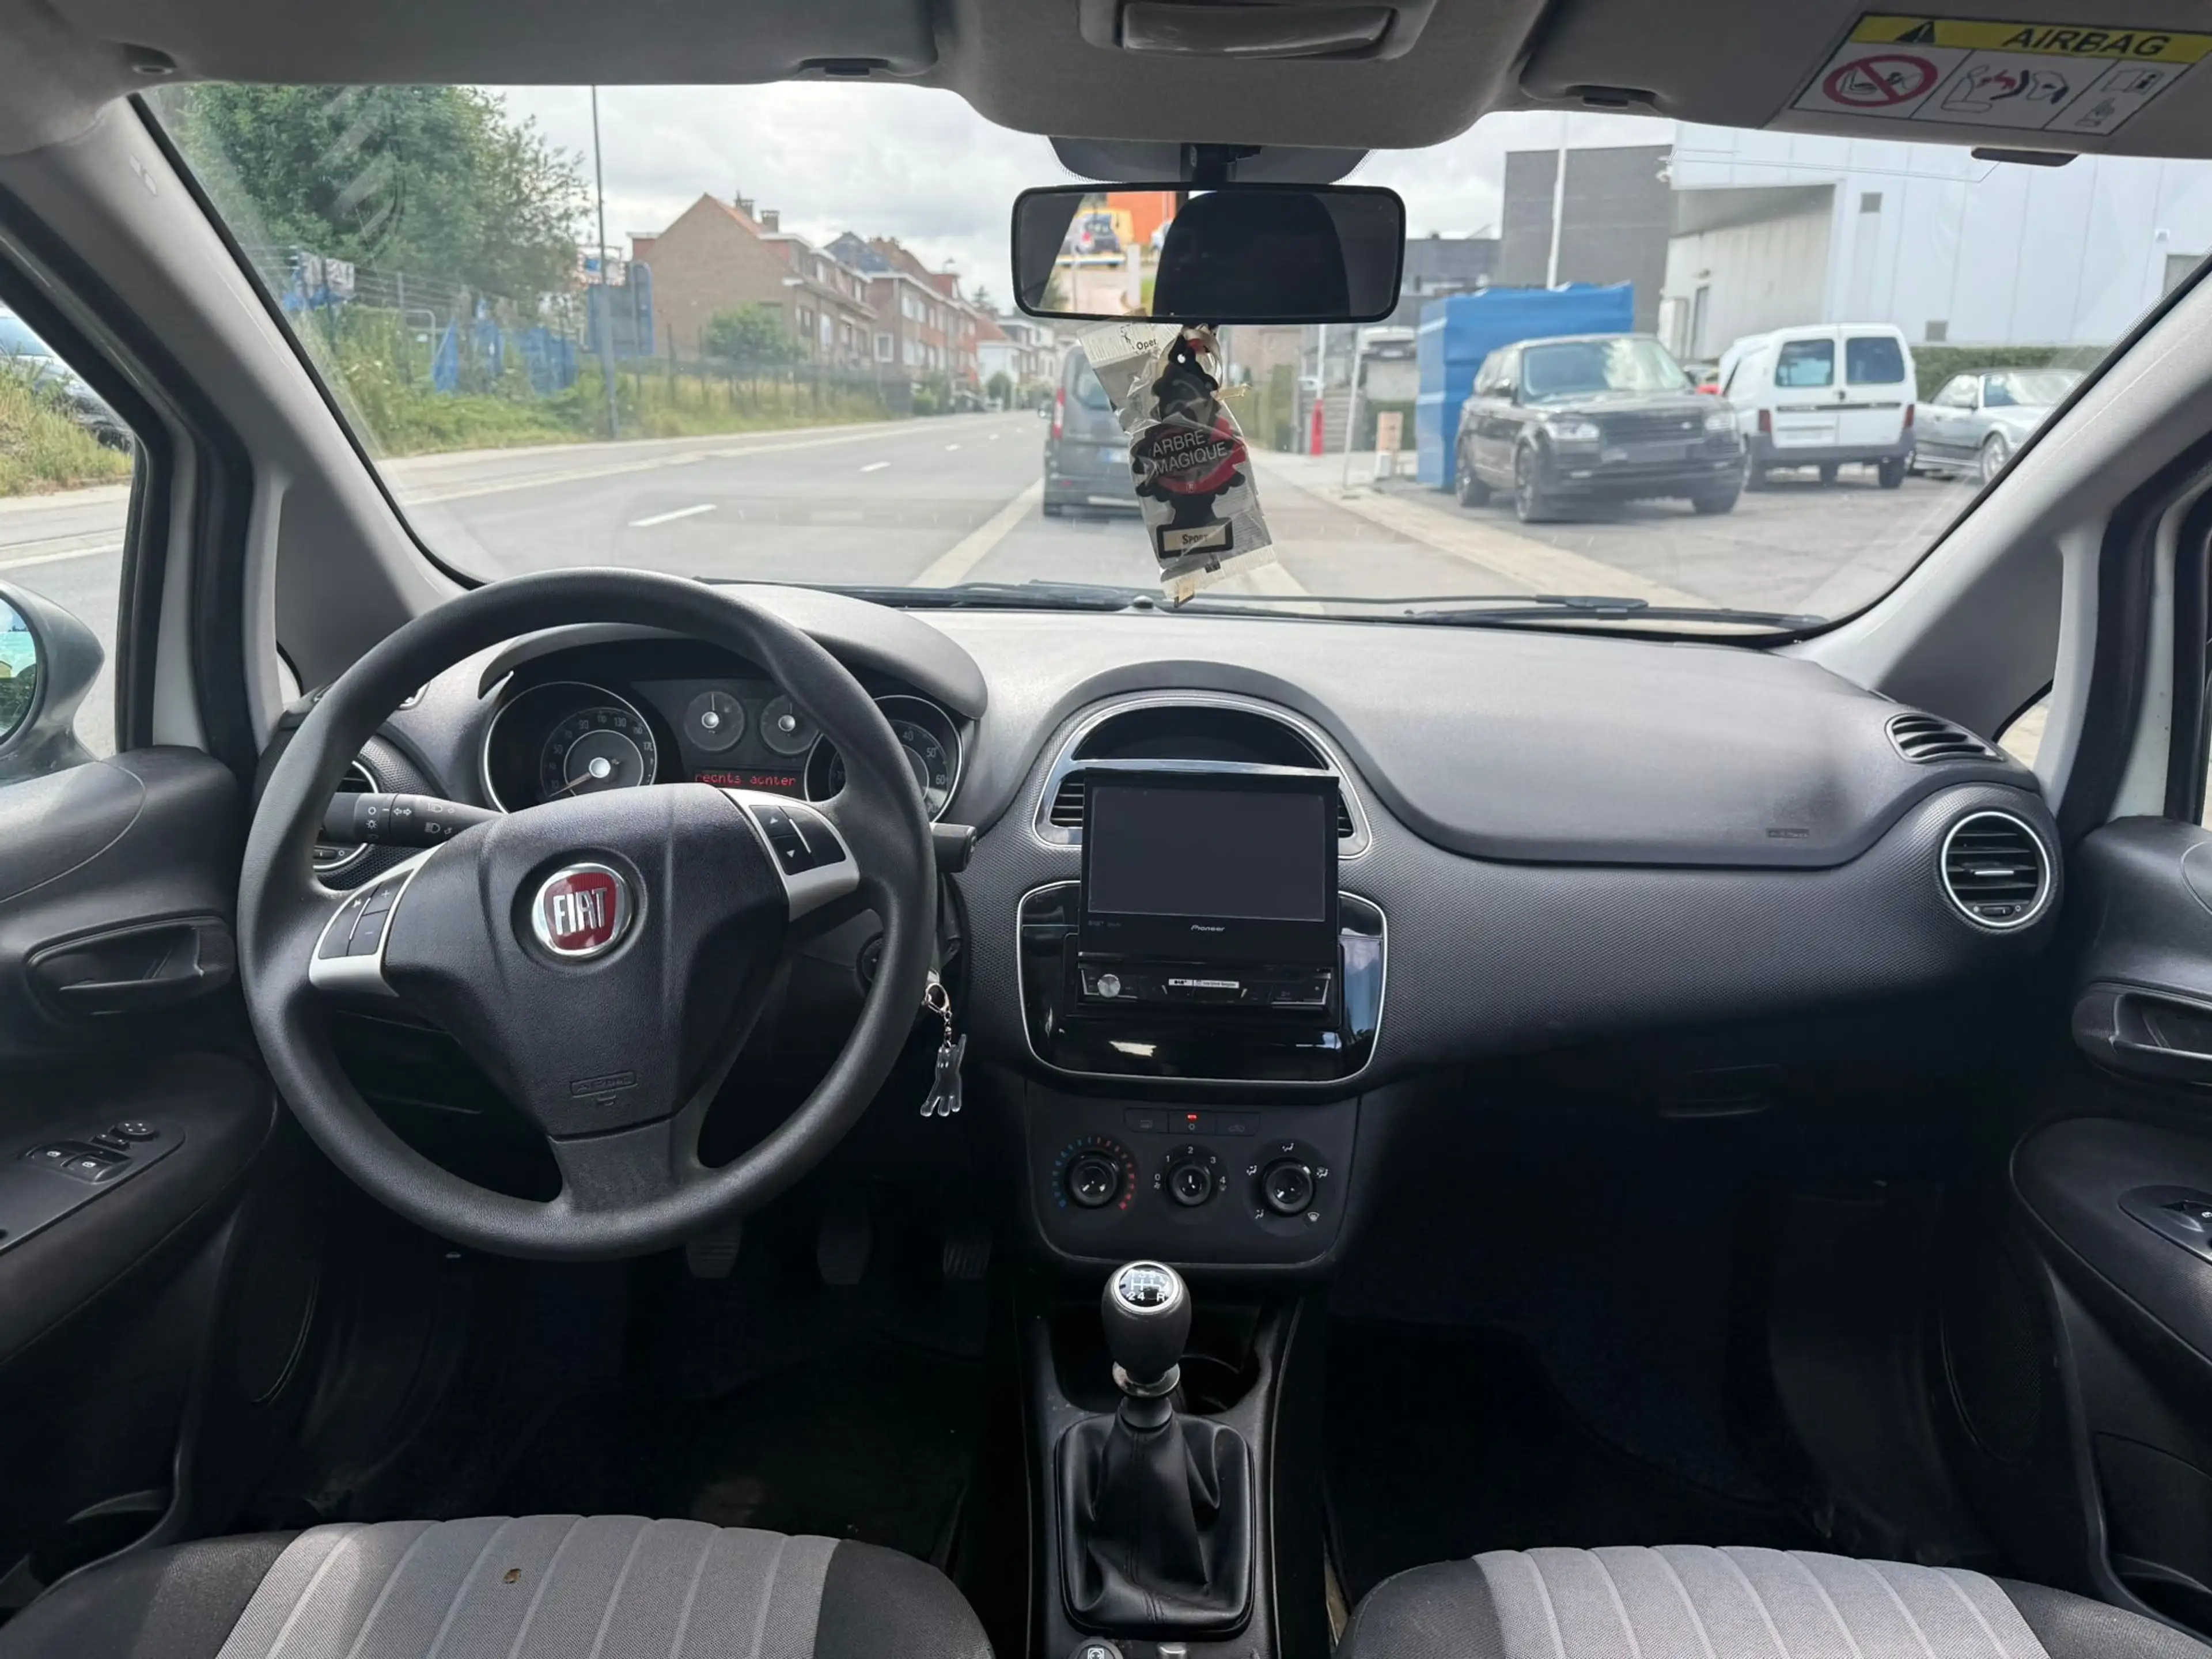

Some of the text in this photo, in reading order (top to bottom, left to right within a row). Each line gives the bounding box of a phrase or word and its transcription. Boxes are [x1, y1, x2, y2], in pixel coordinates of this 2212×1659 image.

[2001, 28, 2171, 56] AIRBAG
[1153, 429, 1206, 457] ARBRE
[1154, 441, 1228, 475] MAGIQUE
[579, 719, 589, 730] 90
[903, 730, 914, 741] 40
[554, 744, 563, 754] 50
[926, 748, 937, 758] 50
[935, 774, 945, 785] 60
[553, 887, 608, 935] FIAT
[1191, 924, 1225, 932] Pioneer
[1188, 1146, 1194, 1154] 2
[1210, 1156, 1216, 1164] 3
[1219, 1176, 1226, 1184] 4
[1128, 1291, 1165, 1302] 2 4 R
